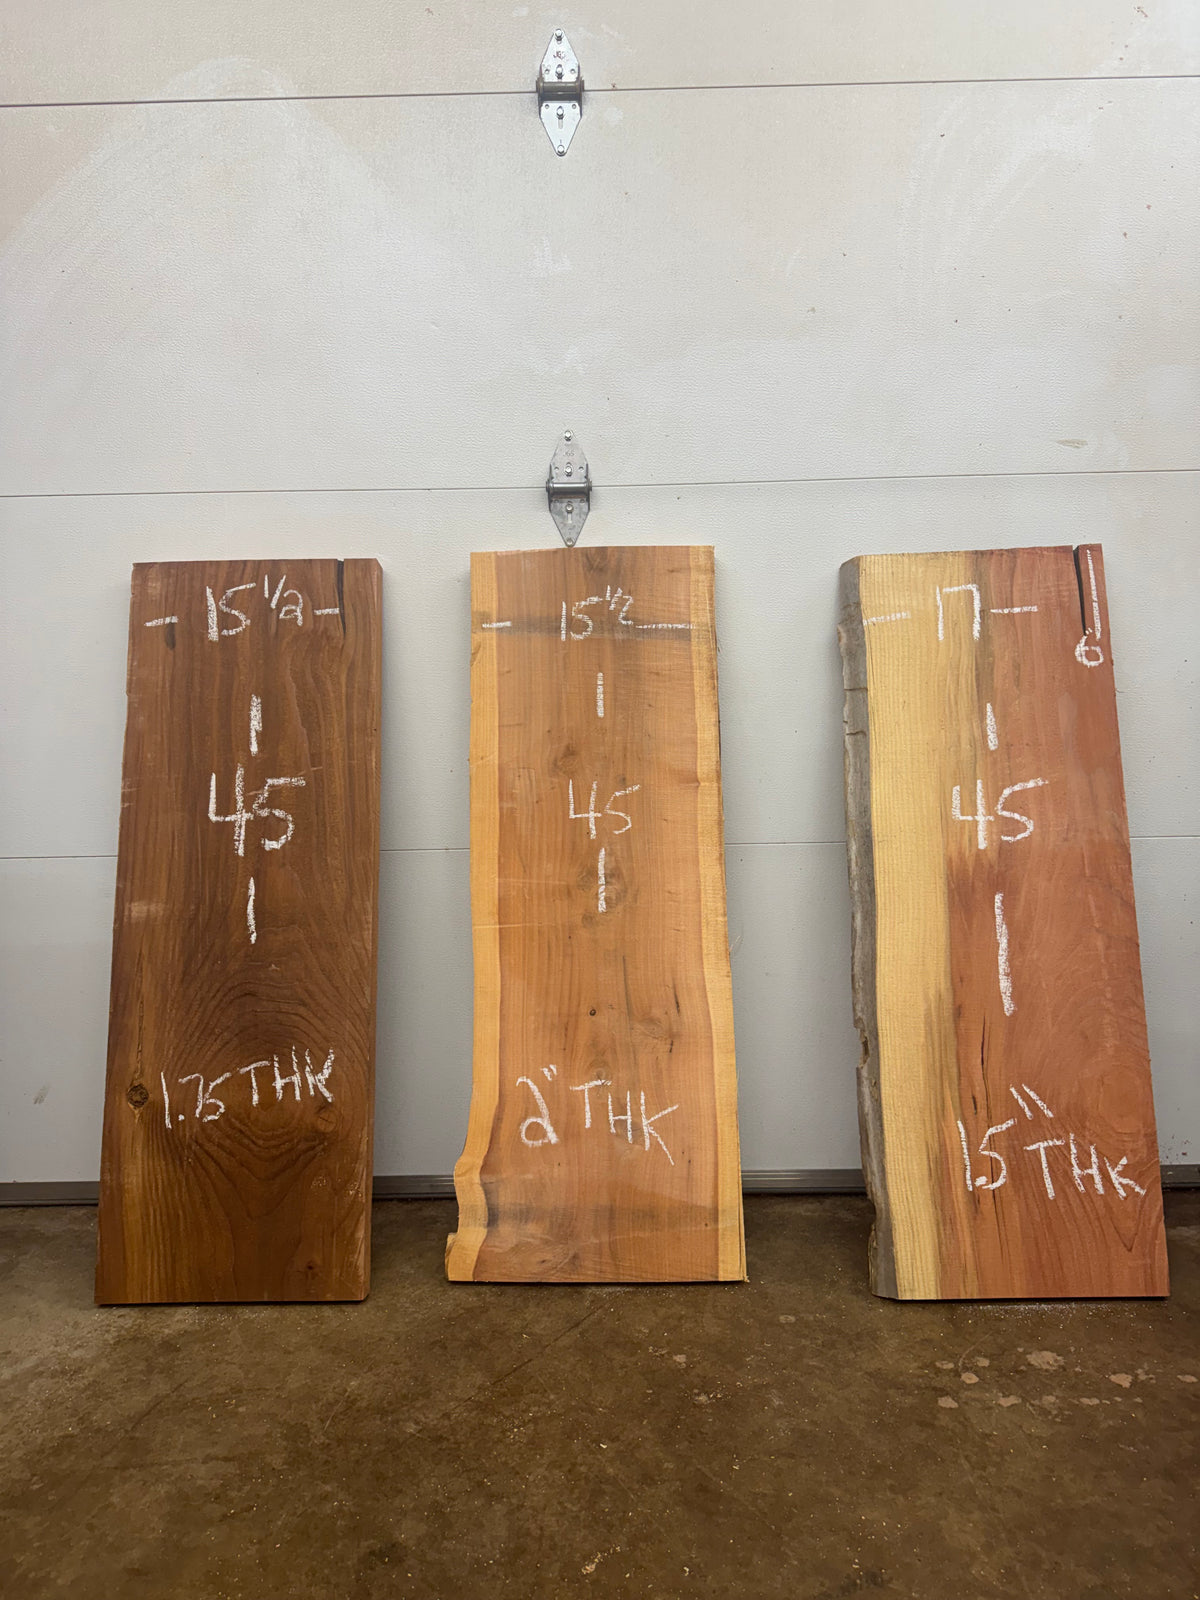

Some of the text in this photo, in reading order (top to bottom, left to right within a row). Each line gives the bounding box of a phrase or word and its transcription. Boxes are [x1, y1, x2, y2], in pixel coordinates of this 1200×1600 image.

[206, 582, 256, 642] 15
[560, 596, 603, 641] 15
[936, 583, 982, 641] 17
[207, 763, 306, 857] 45
[568, 779, 641, 839] 45
[951, 777, 1049, 850] 45
[160, 1044, 335, 1130] 1.75 THK
[569, 1079, 680, 1166] THK
[1023, 1132, 1147, 1200] THK
